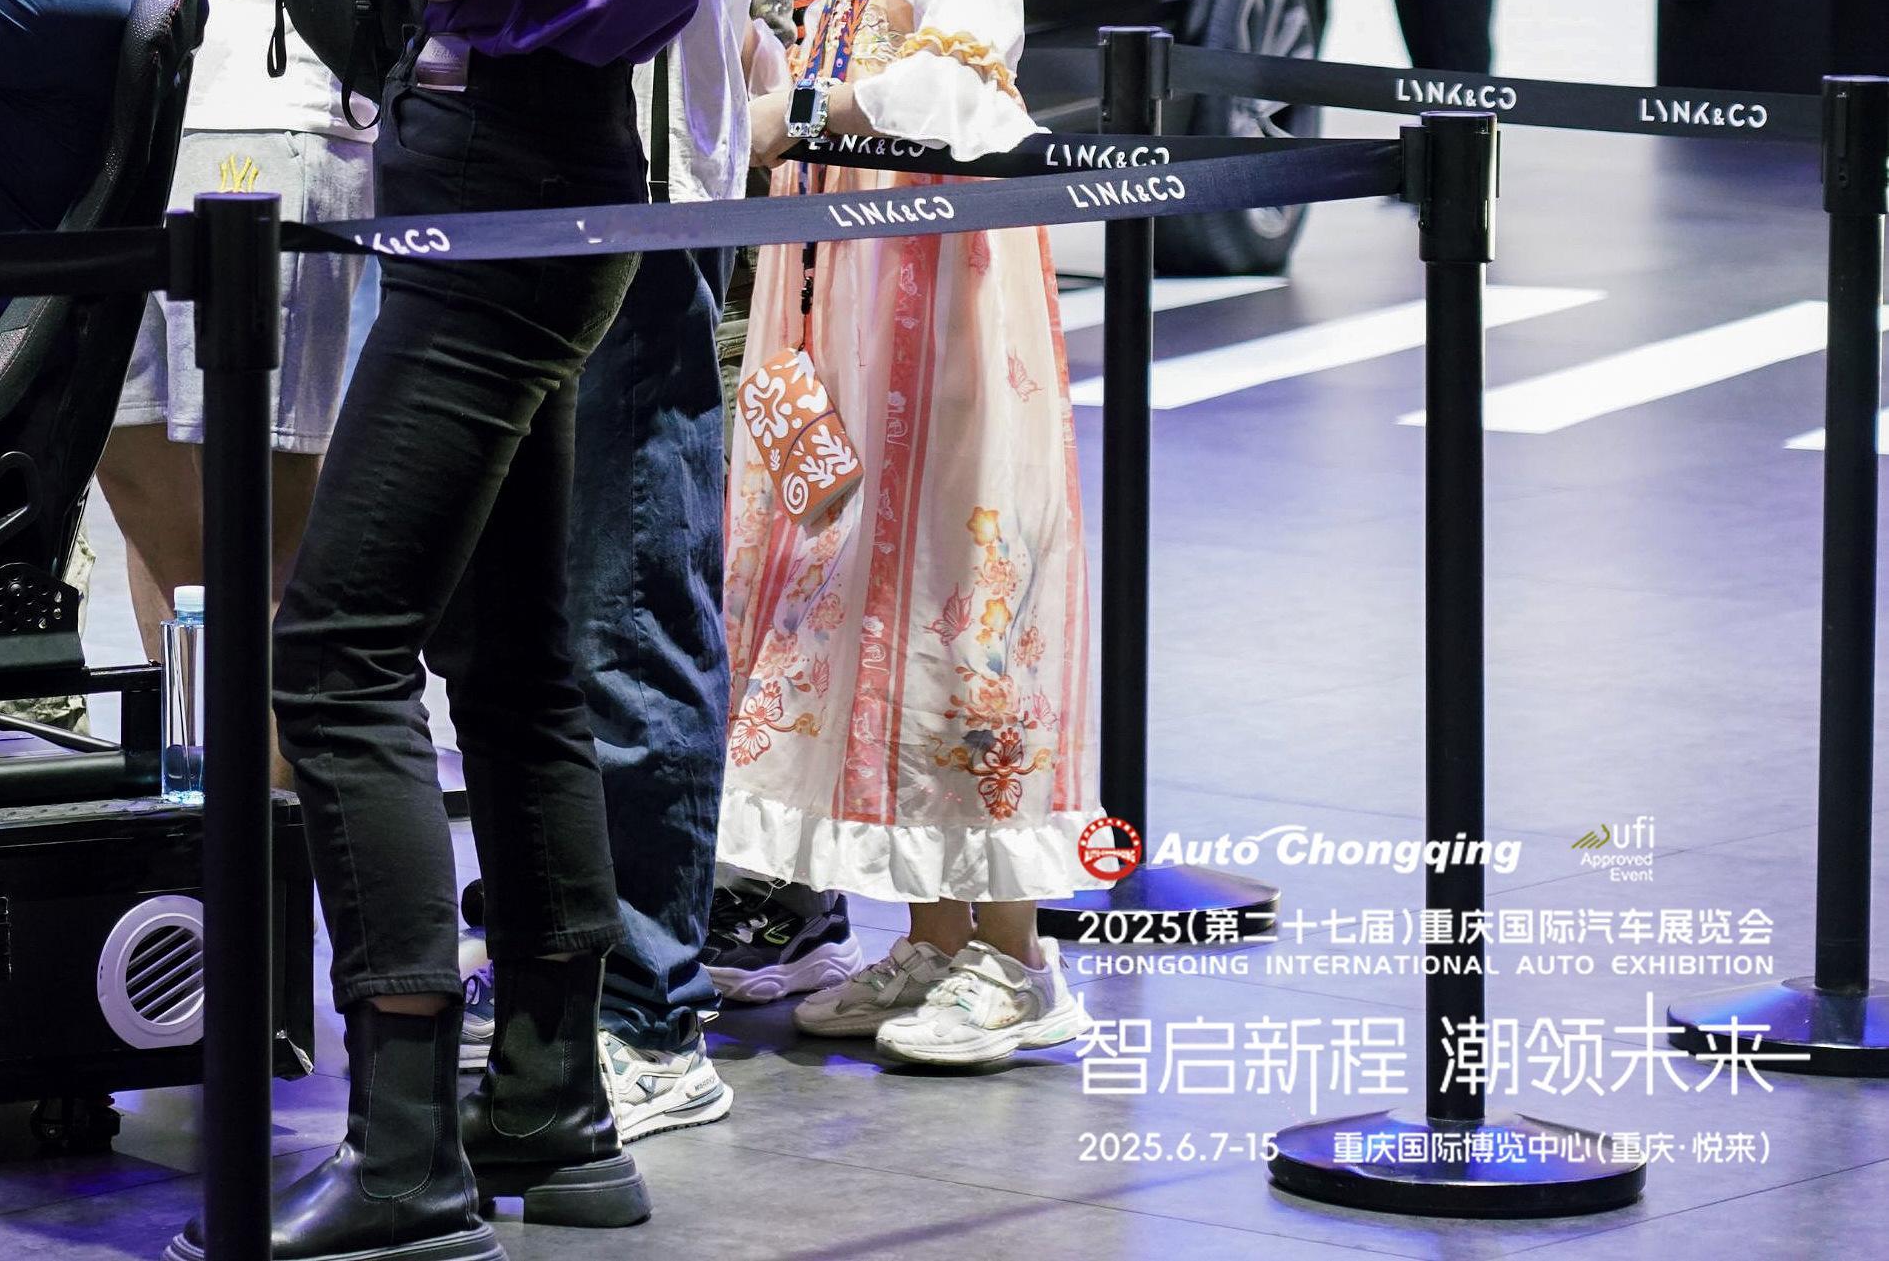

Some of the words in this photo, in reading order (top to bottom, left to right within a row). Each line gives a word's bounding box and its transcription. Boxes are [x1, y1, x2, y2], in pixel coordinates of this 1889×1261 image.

[1396, 77, 1517, 109] LYNK&CO
[1640, 97, 1768, 129] LYNK&CO
[1045, 143, 1171, 168] LYNK&CO
[1065, 175, 1186, 209] LYNK&CO
[827, 196, 955, 228] LYNK&CO
